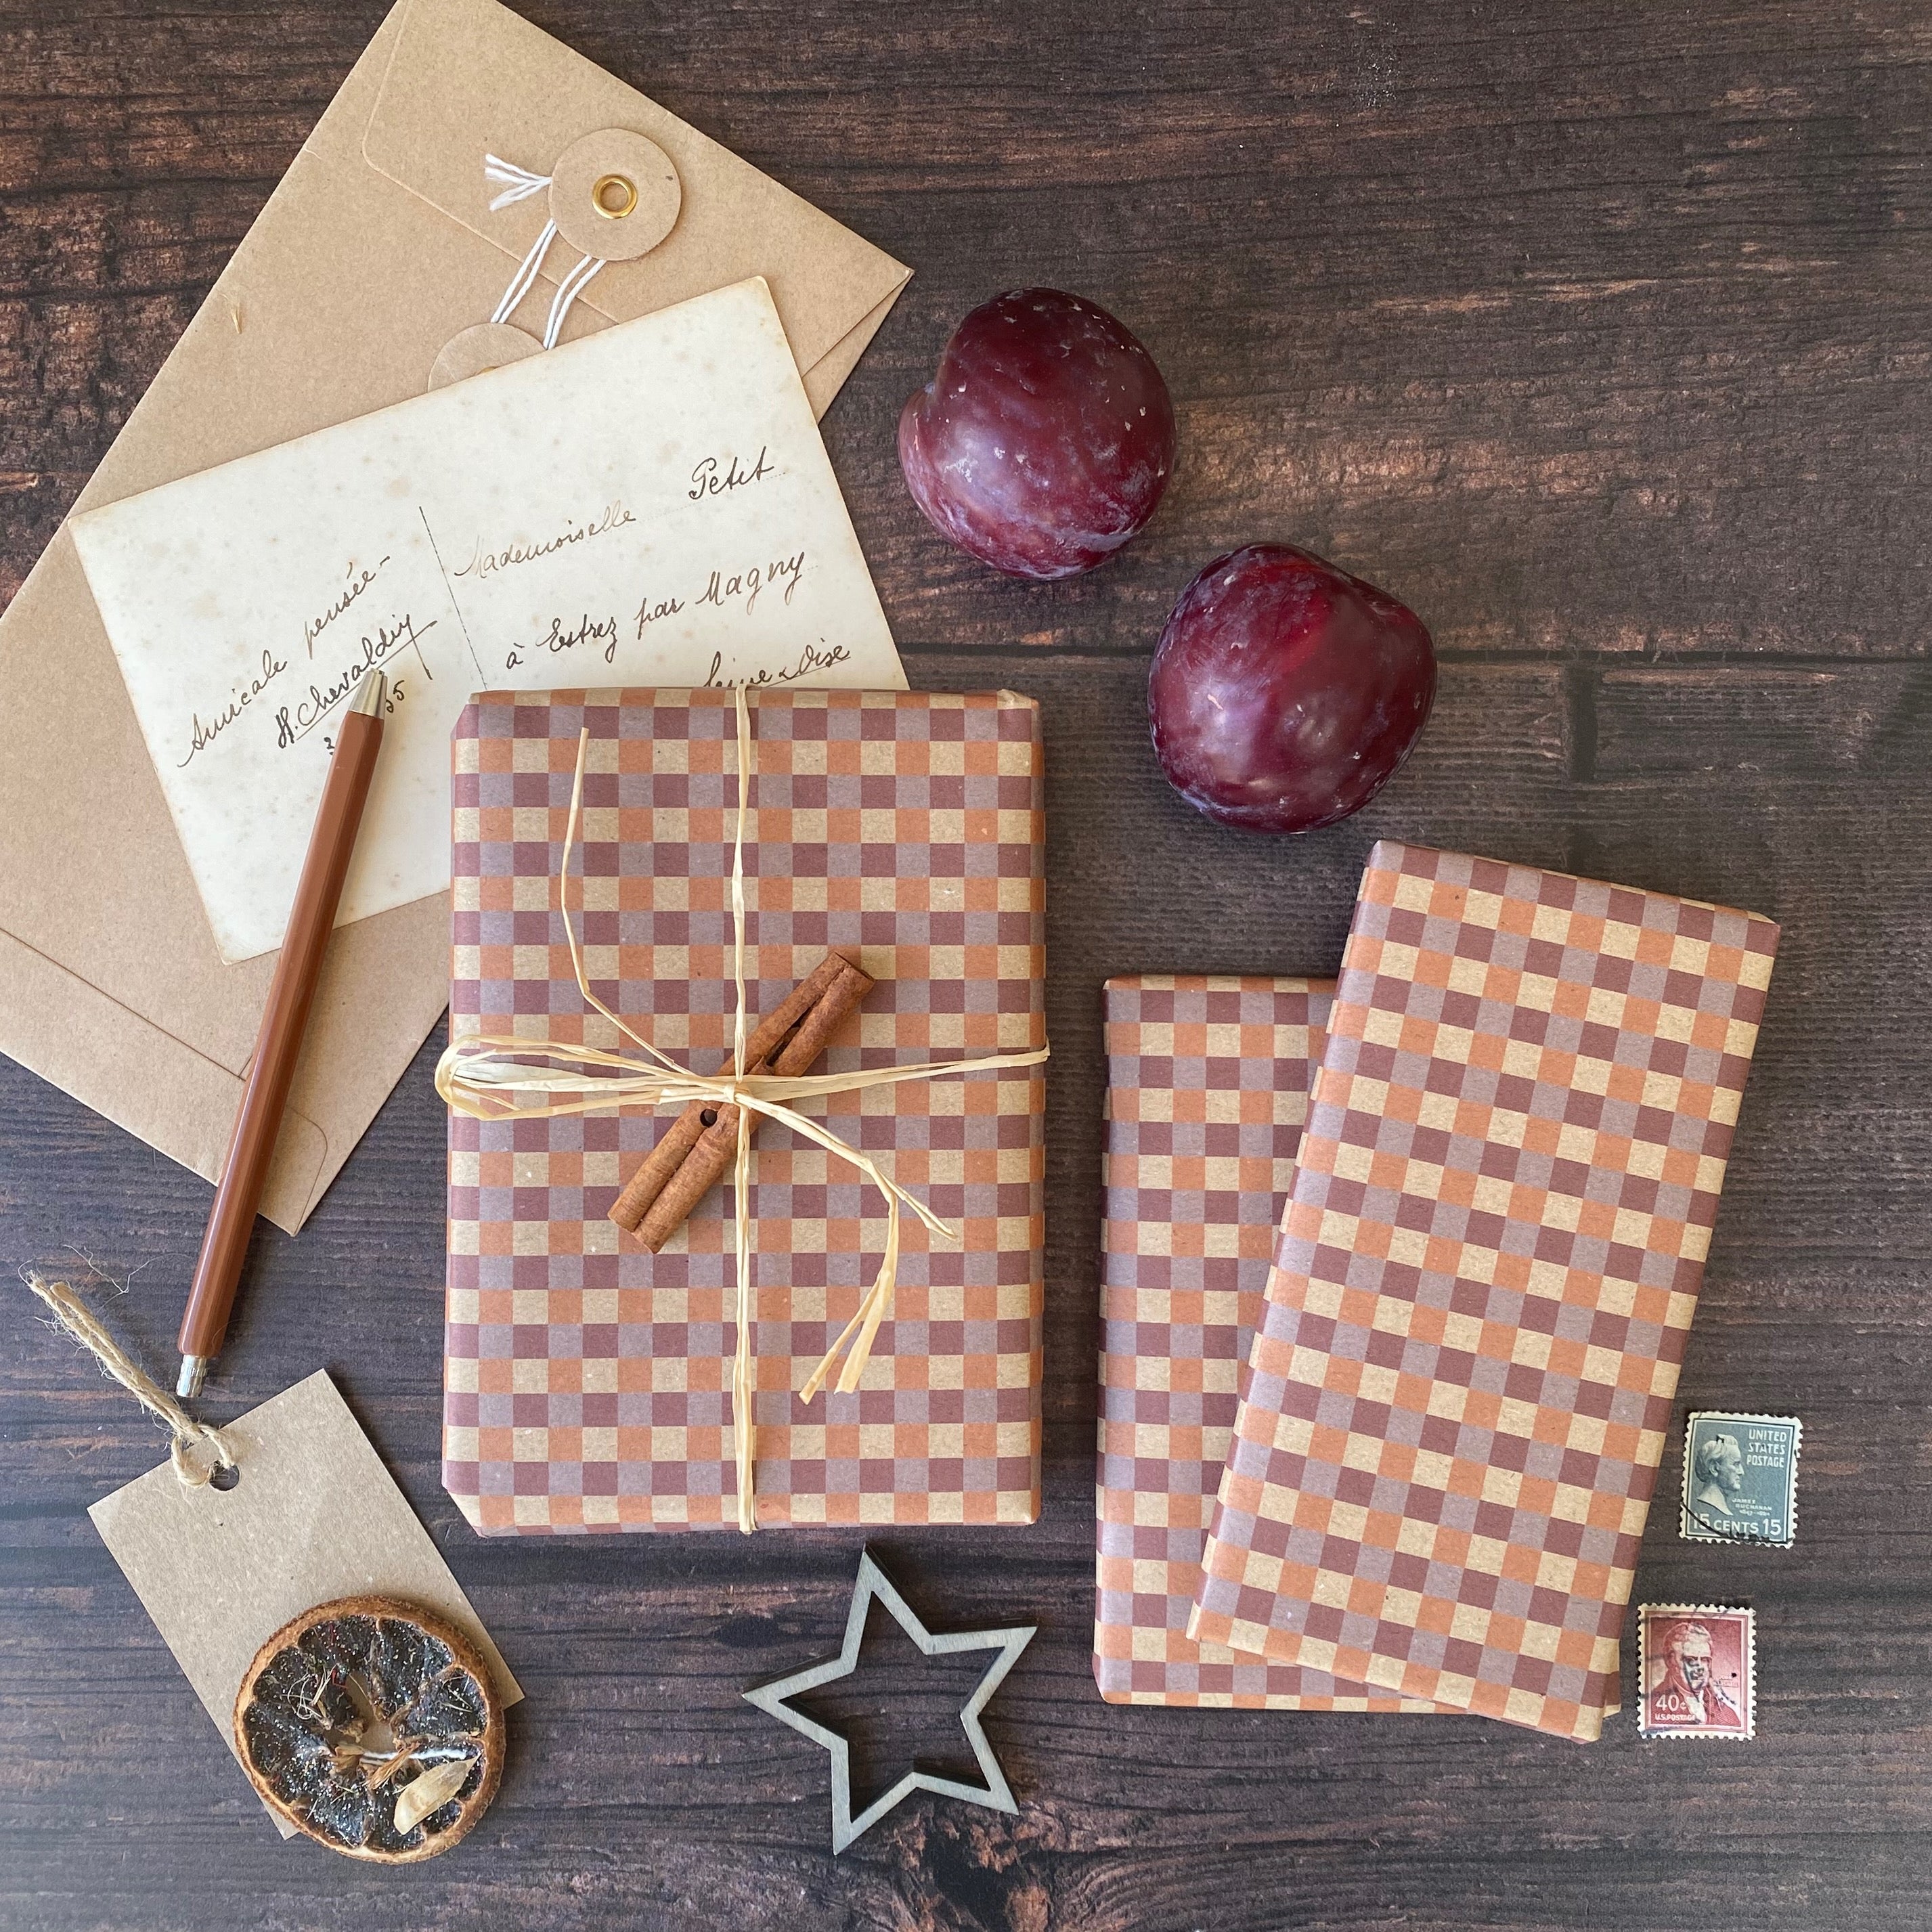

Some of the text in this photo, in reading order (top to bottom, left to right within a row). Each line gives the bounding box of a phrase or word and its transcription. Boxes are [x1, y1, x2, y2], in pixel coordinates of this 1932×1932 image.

[454, 445, 775, 579] Mademoiselle Petit
[633, 597, 686, 640] par
[695, 551, 805, 615] Magny
[1749, 1428, 1787, 1442] UNITED
[1748, 1442, 1786, 1455] STATES
[1747, 1454, 1784, 1468] POSTAGE
[1692, 1512, 1782, 1536] 15 CENTS 15
